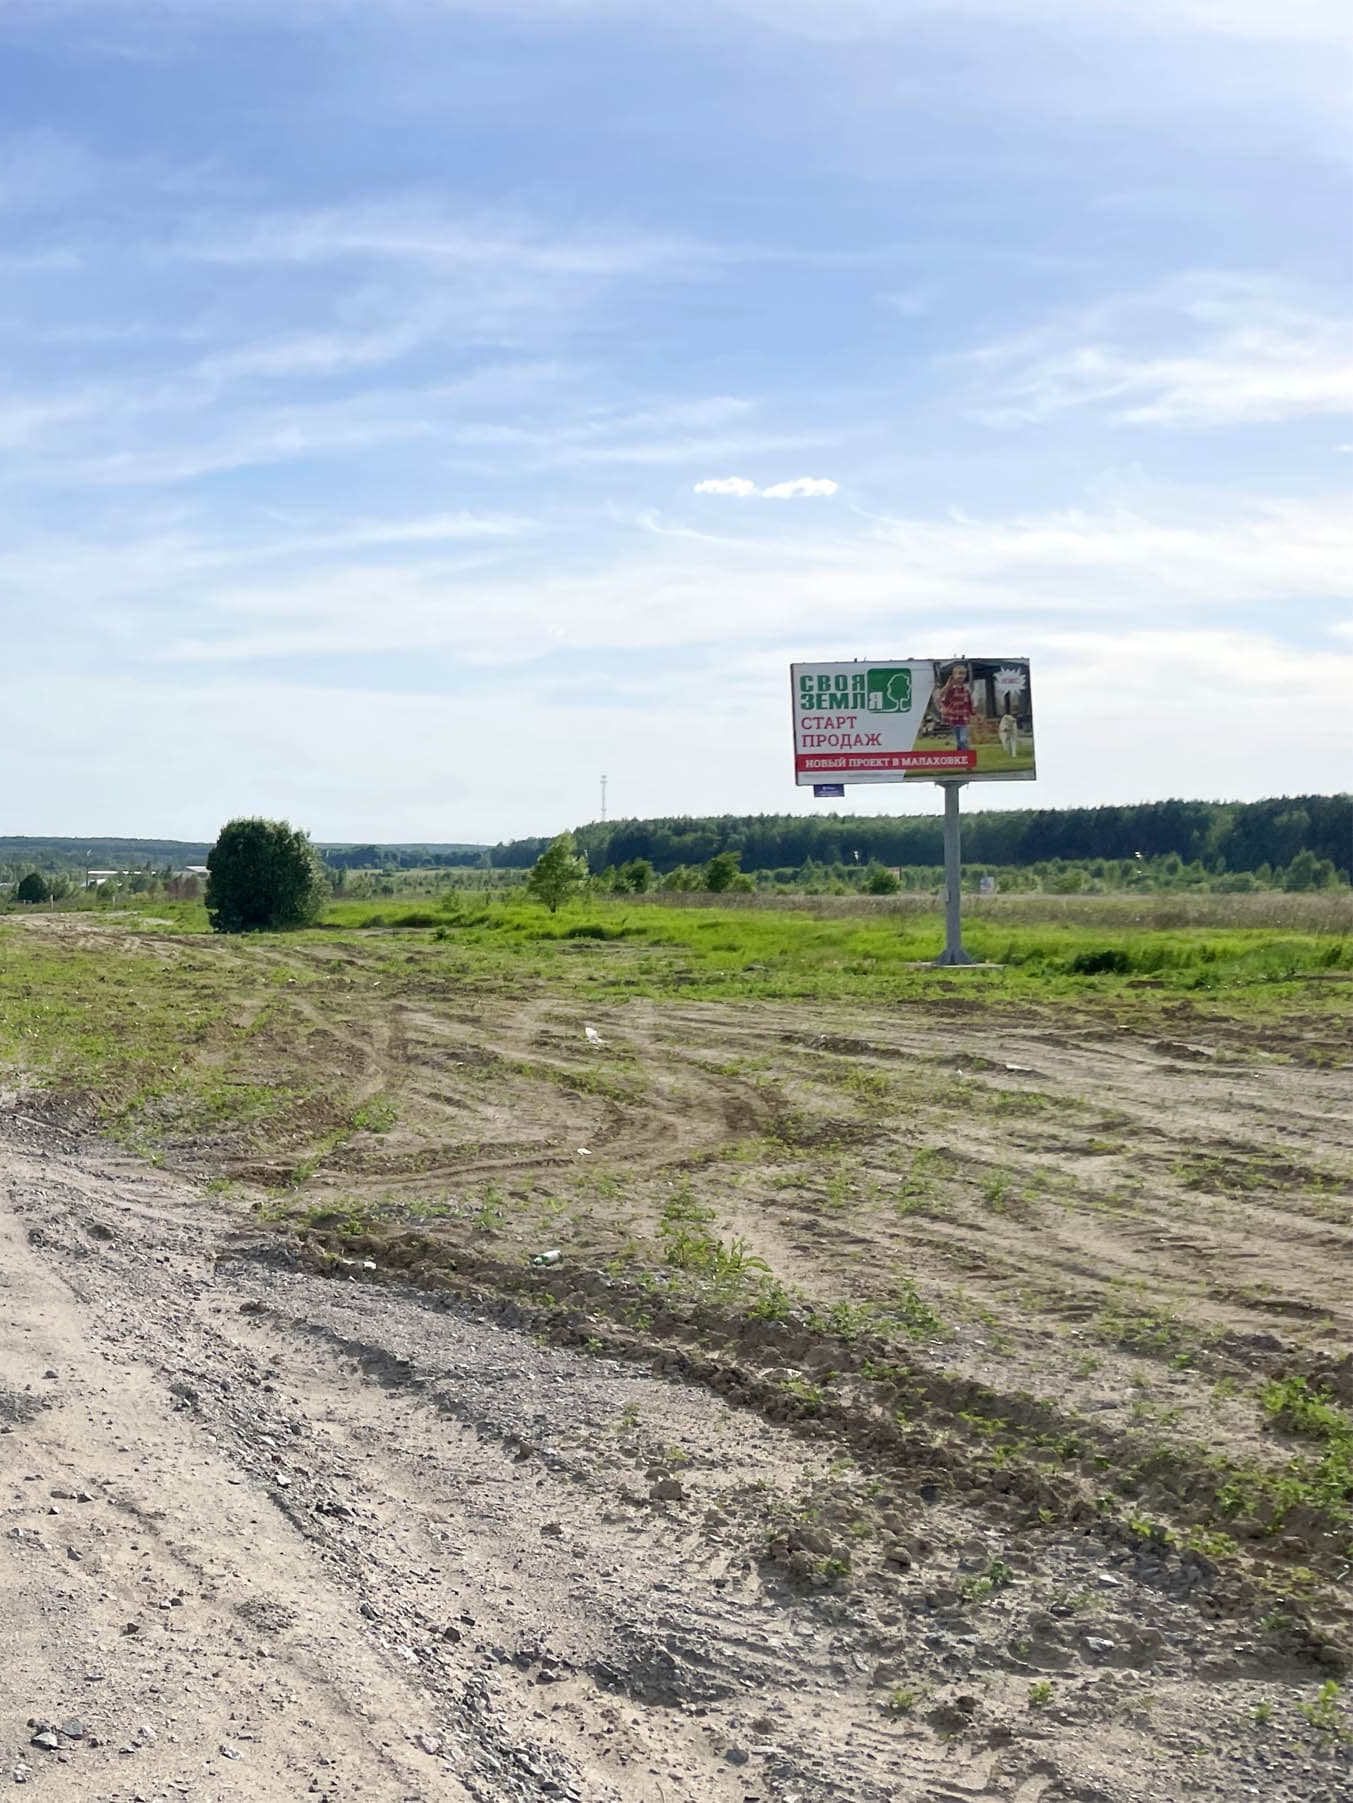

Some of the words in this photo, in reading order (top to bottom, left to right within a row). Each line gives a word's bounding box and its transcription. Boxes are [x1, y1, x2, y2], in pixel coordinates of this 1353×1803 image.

[800, 674, 865, 692] СВОЯ
[800, 692, 883, 710] ЗЕМЛЯ
[801, 716, 857, 730] СТАРТ
[802, 733, 882, 749] ПРОДАЖ
[805, 757, 846, 768] НОВЫЙ
[848, 757, 888, 767] ПРОЕКТ
[892, 757, 899, 766] В
[901, 755, 968, 766] МАЛАХОВКЕ
